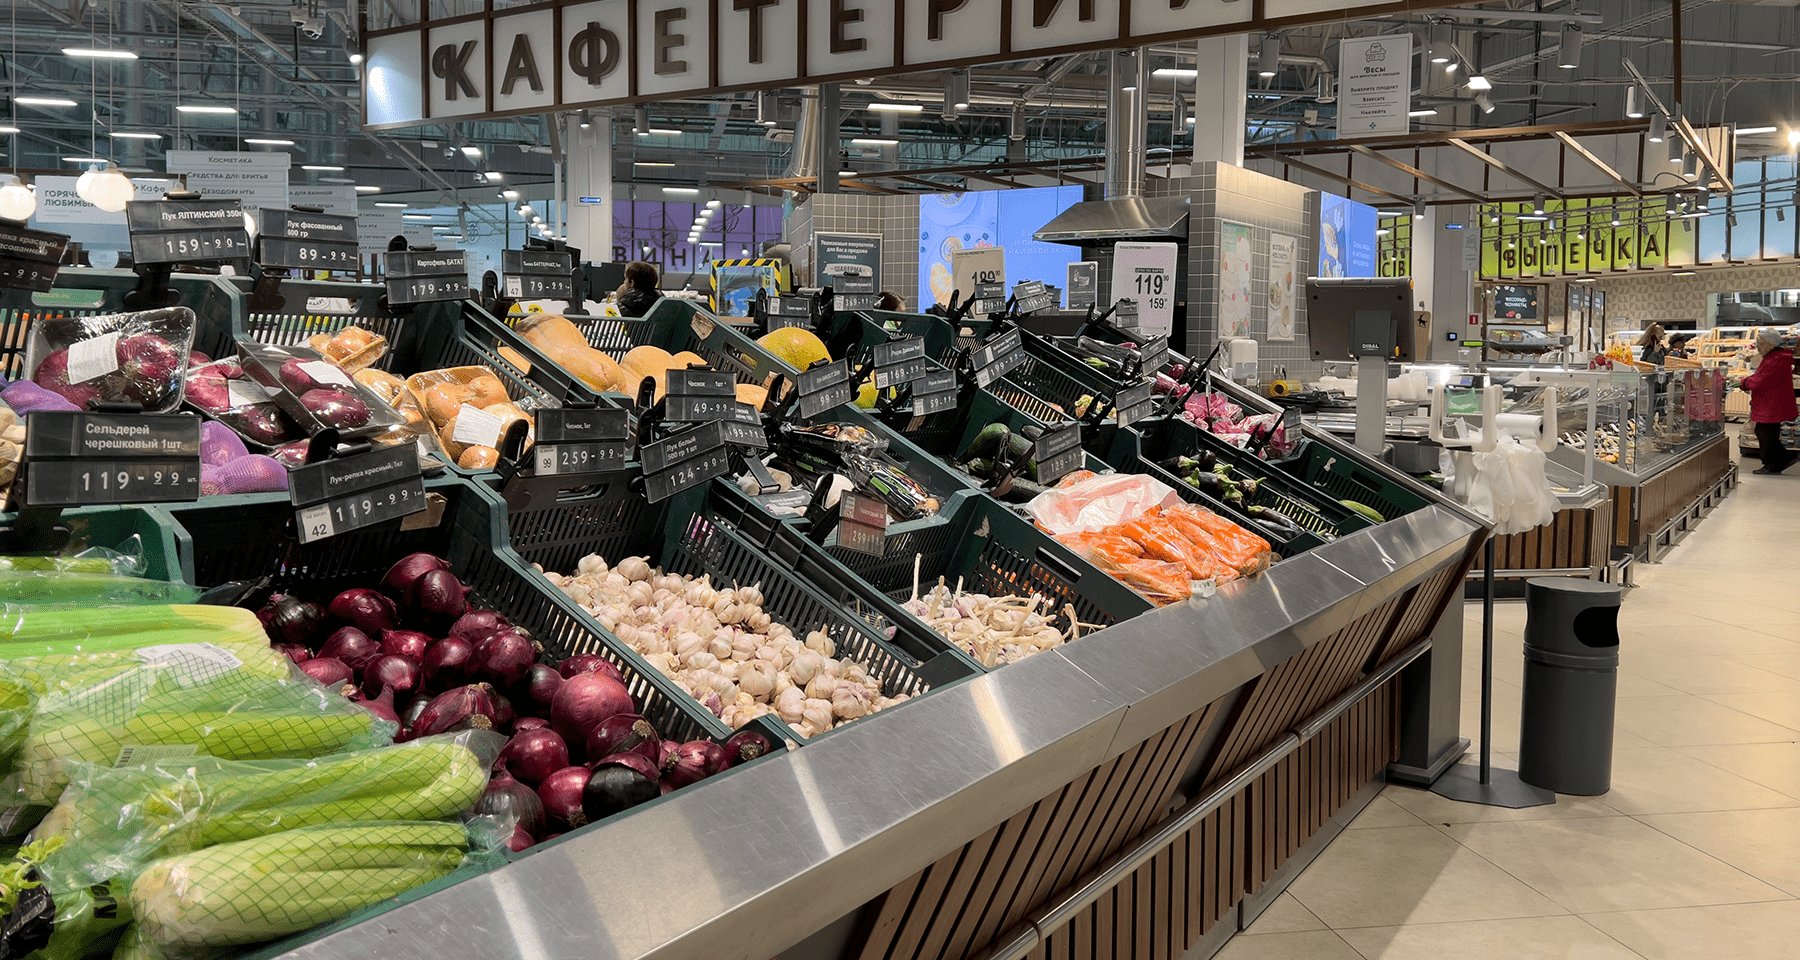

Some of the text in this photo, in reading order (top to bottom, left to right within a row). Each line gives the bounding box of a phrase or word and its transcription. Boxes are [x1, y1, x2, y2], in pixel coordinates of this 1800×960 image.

[432, 0, 1240, 101] КАФЕТЕР
[162, 211, 177, 221] Лук
[178, 209, 226, 219] ЯЛТИНСКИЙ
[287, 220, 300, 228] Лук
[1503, 234, 1661, 269] ВЫПЕЧКА
[446, 258, 464, 266] БАТАТ
[1135, 274, 1163, 295] 119
[1149, 298, 1165, 309] 159
[85, 423, 150, 437] Сельдерей
[85, 439, 158, 451] черешковый
[329, 470, 364, 485] Лук-репка
[311, 524, 328, 537] 42
